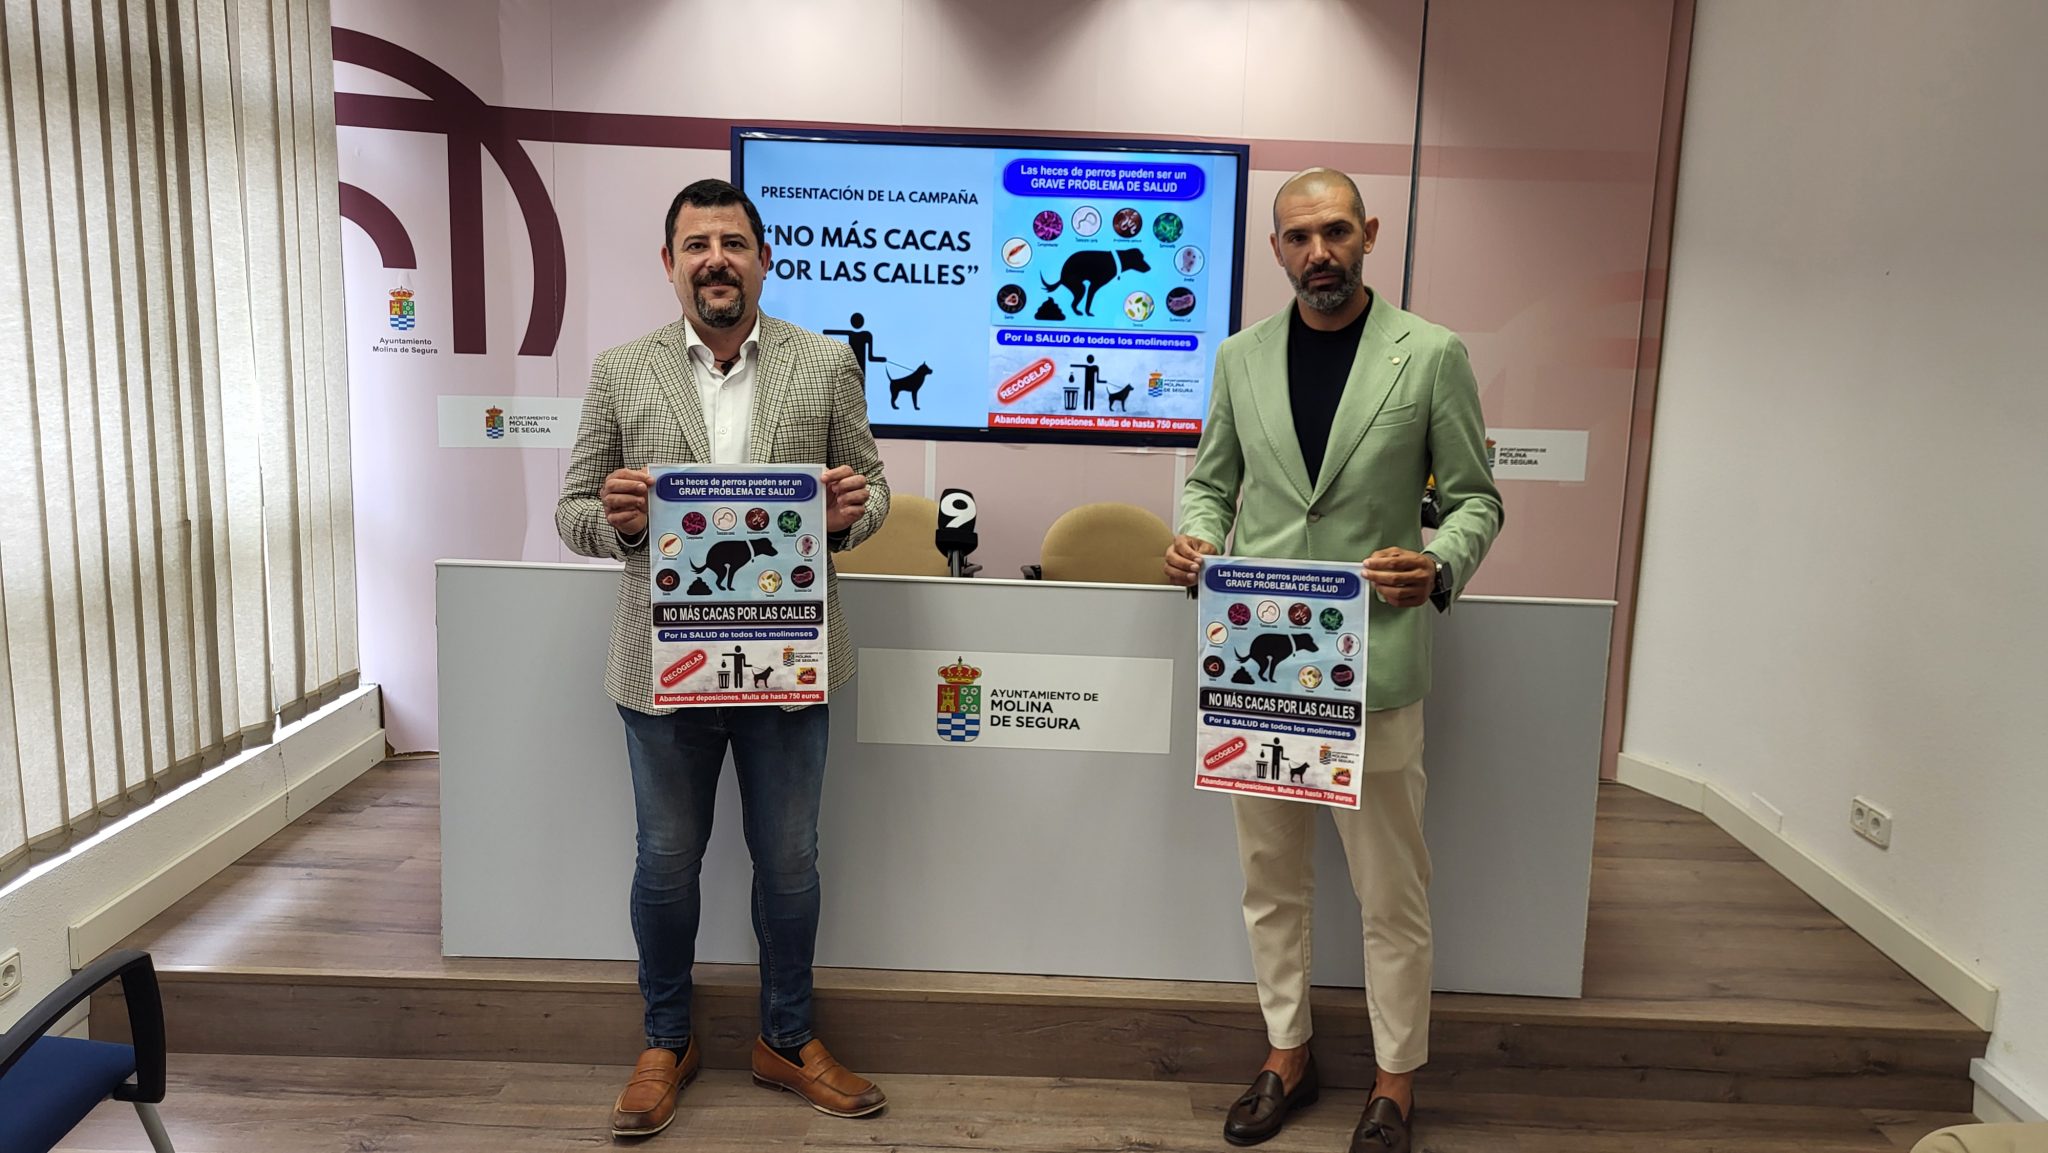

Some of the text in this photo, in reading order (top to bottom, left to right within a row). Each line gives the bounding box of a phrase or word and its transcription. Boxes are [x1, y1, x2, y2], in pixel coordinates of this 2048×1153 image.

[1021, 165, 1038, 176] Las
[1041, 166, 1068, 177] heces
[1071, 167, 1083, 177] de
[1086, 170, 1116, 180] perros
[1119, 168, 1154, 181] pueden
[1031, 179, 1177, 192] GRAVE PROBLEMA DE SALUD
[762, 186, 978, 205] PRESENTACIÓN DE LA CAMPAÑA
[822, 221, 877, 248] MÁS
[884, 229, 971, 252] CACAS
[821, 260, 866, 282] LAS
[874, 262, 978, 285] CALLES”
[379, 337, 431, 345] Ayuntamiento
[1035, 334, 1070, 344] SALUD
[1073, 335, 1085, 344] de
[1088, 336, 1115, 345] todos
[1118, 337, 1132, 345] los
[1135, 338, 1191, 347] molinenses
[1000, 363, 1052, 399] RECÓGELAS
[994, 414, 1037, 424] Abandonar
[1040, 416, 1095, 428] deposiciones.
[1097, 418, 1120, 428] Multa
[1122, 419, 1131, 428] de
[1132, 420, 1154, 429] hasta
[1157, 420, 1170, 429] 750
[749, 478, 776, 487] pueden
[679, 487, 795, 496] GRAVE PROBLEMA DE SALUD
[941, 492, 976, 528] 9
[1232, 570, 1254, 579] heces
[1292, 574, 1320, 583] pueden
[1226, 579, 1252, 587] GRAVE
[1254, 581, 1297, 590] PROBLEMA
[1311, 584, 1338, 593] SALUD
[663, 605, 816, 621] NO MÁS CACAS POR LAS CALLES
[663, 653, 704, 683] RECÓGELAS
[990, 689, 1098, 701] AYUNTAMIENTO DE
[991, 700, 1053, 713] MOLINA
[1209, 692, 1355, 719] NO MÁS CACAS POR LAS CALLES
[990, 715, 1080, 730] DE SEGURA
[1232, 719, 1258, 728] SALUD
[1307, 727, 1350, 737] molinenses
[1206, 741, 1244, 765] RECÓGELAS
[1201, 777, 1233, 787] Abandonar
[1235, 781, 1276, 792] deposiciones.
[1278, 787, 1294, 795] Multa
